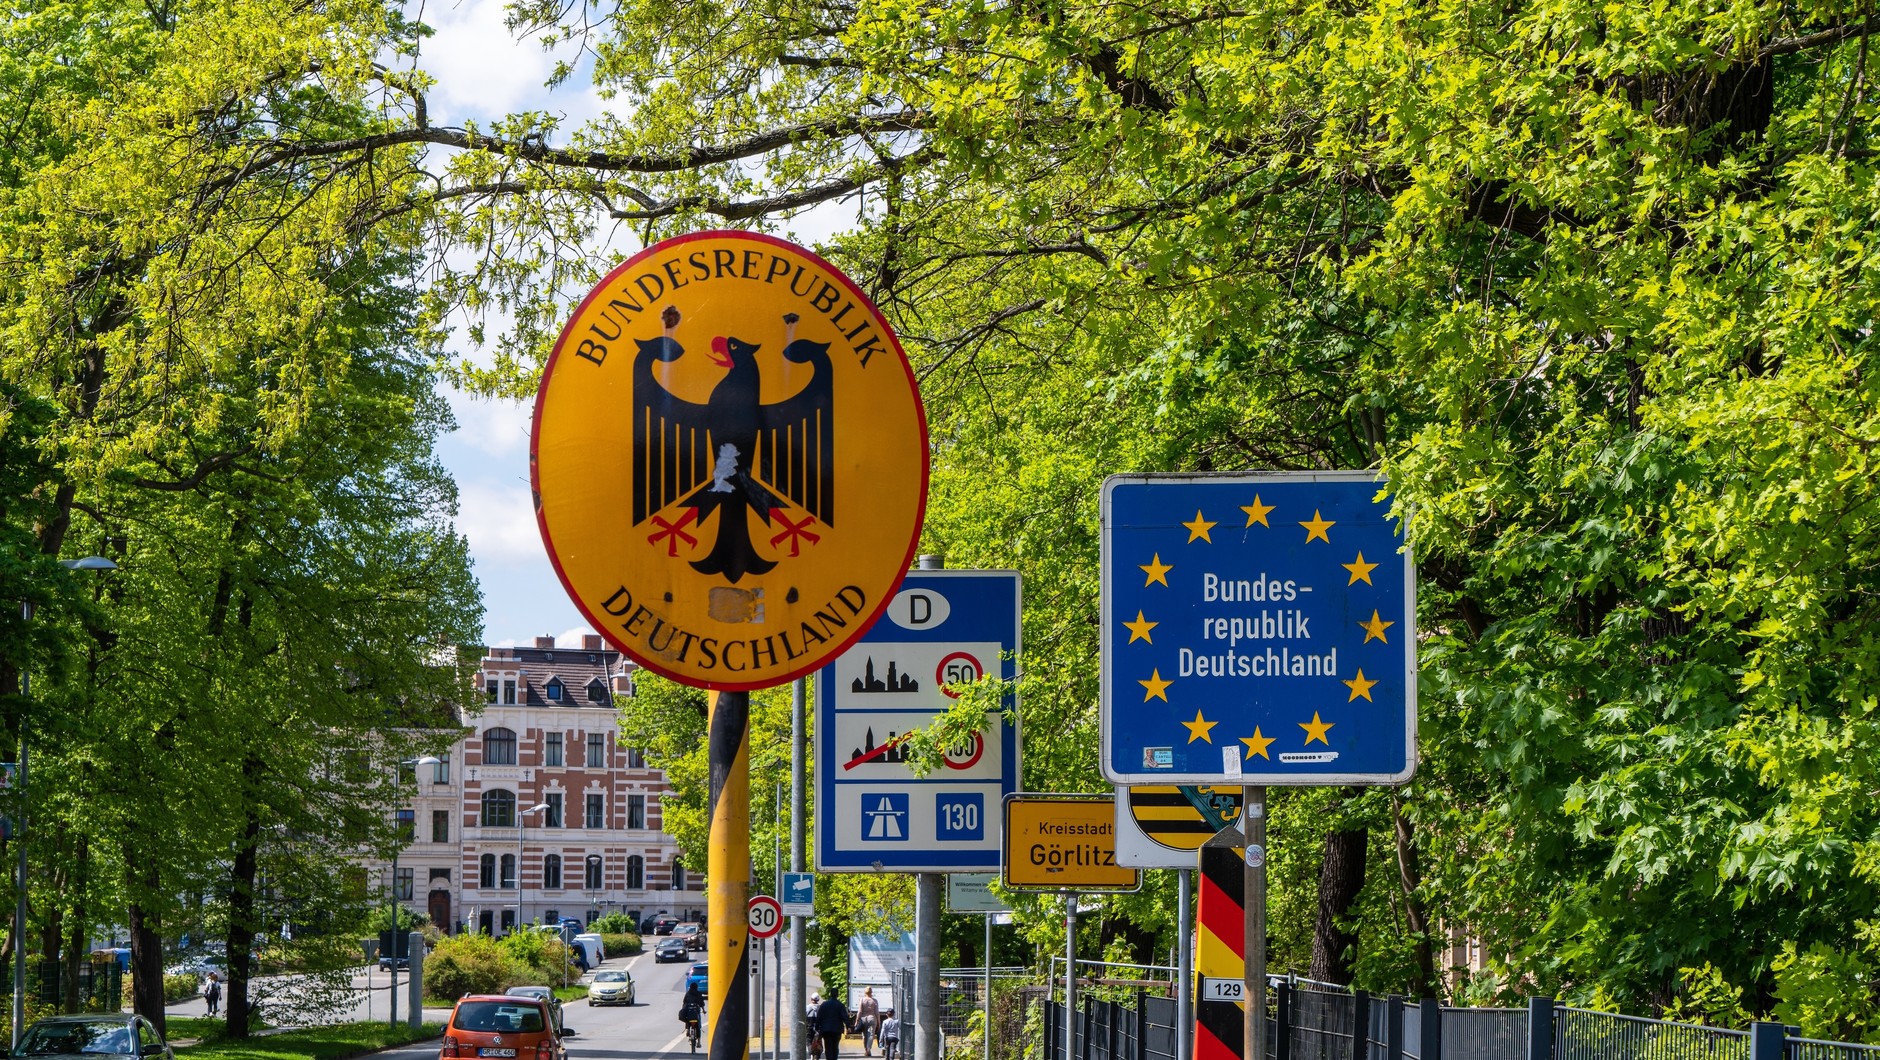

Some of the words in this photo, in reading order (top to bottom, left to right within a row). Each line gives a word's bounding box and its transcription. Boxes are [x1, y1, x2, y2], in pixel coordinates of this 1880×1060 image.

[575, 249, 887, 369] BUNDESREPUBLIK
[1203, 573, 1313, 602] Bundes-
[910, 594, 931, 624] D
[600, 585, 866, 671] DEUTSCHLAND
[1203, 609, 1311, 647] republik
[947, 664, 974, 686] 50
[1179, 647, 1337, 677] Deutschland
[942, 803, 978, 831] 130
[1039, 822, 1112, 835] Kreisstadt
[1030, 844, 1115, 866] Görlitz
[751, 908, 775, 926] 30
[1215, 983, 1241, 996] 129
